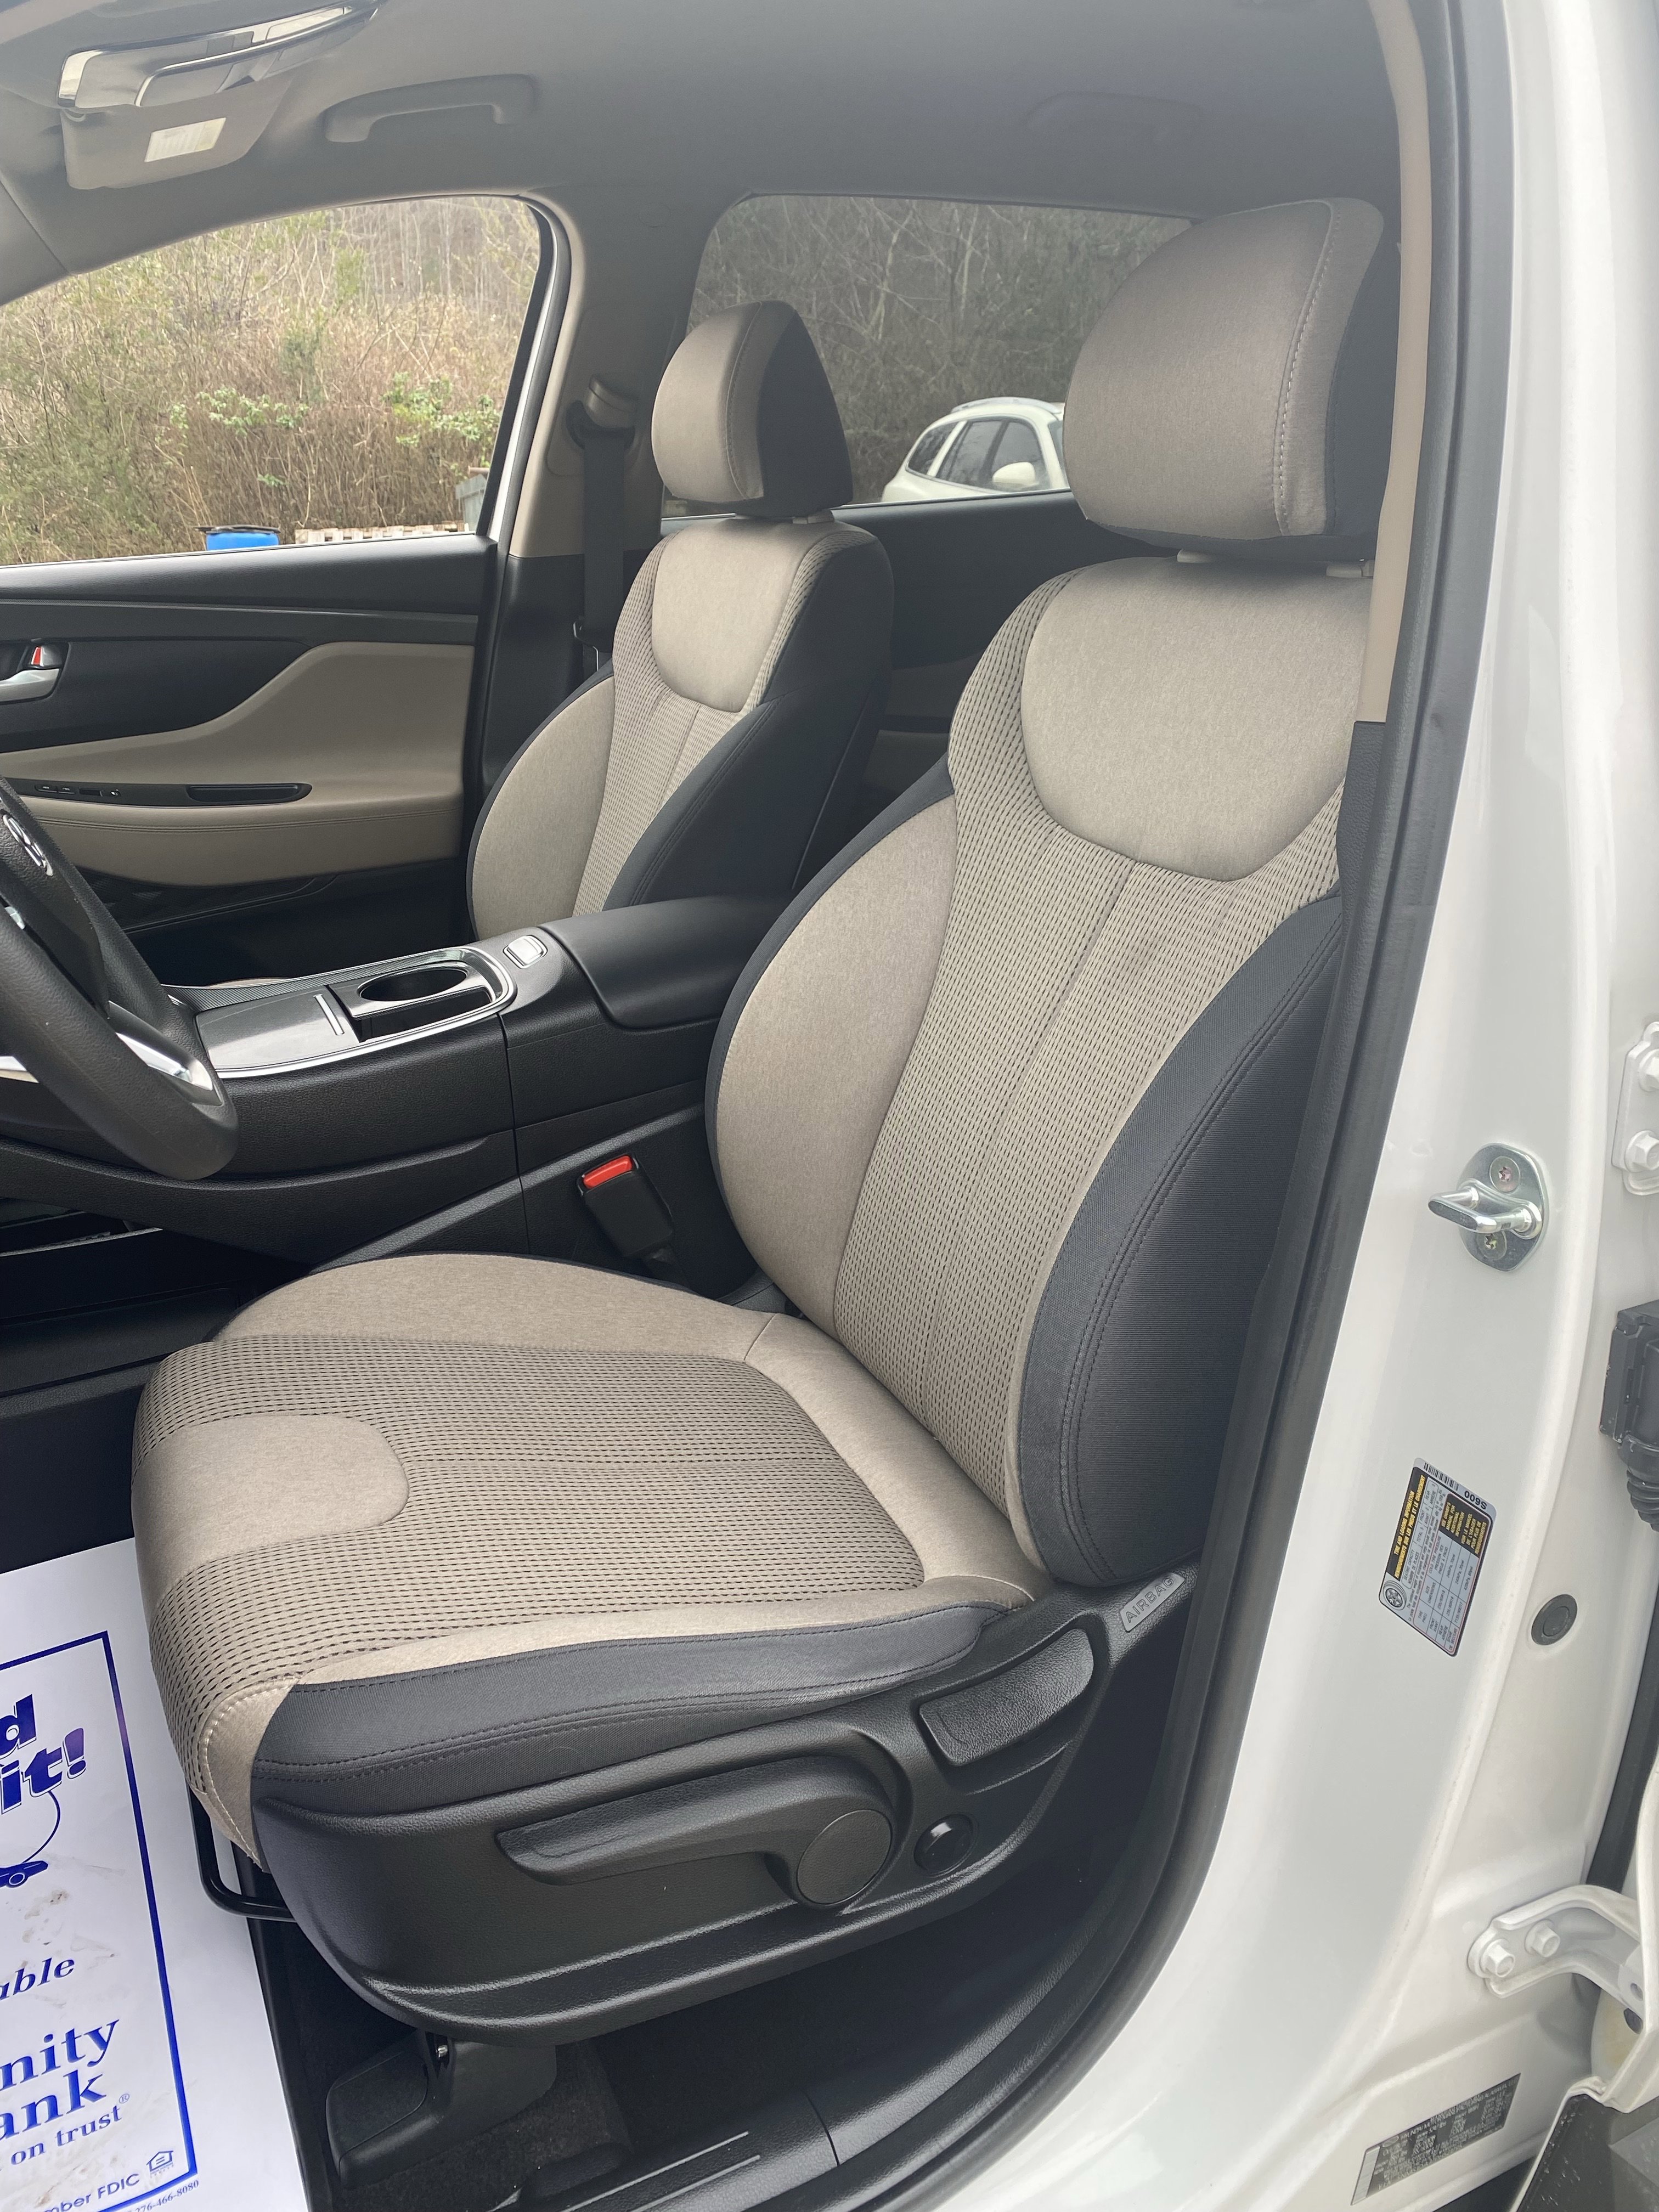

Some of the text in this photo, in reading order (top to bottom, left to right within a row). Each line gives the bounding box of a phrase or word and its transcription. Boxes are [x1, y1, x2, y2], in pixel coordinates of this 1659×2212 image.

[1125, 1576, 1175, 1623] AIRBAG
[0, 2019, 120, 2092] nity
[10, 2142, 46, 2165] on
[97, 2174, 141, 2200] FDIC
